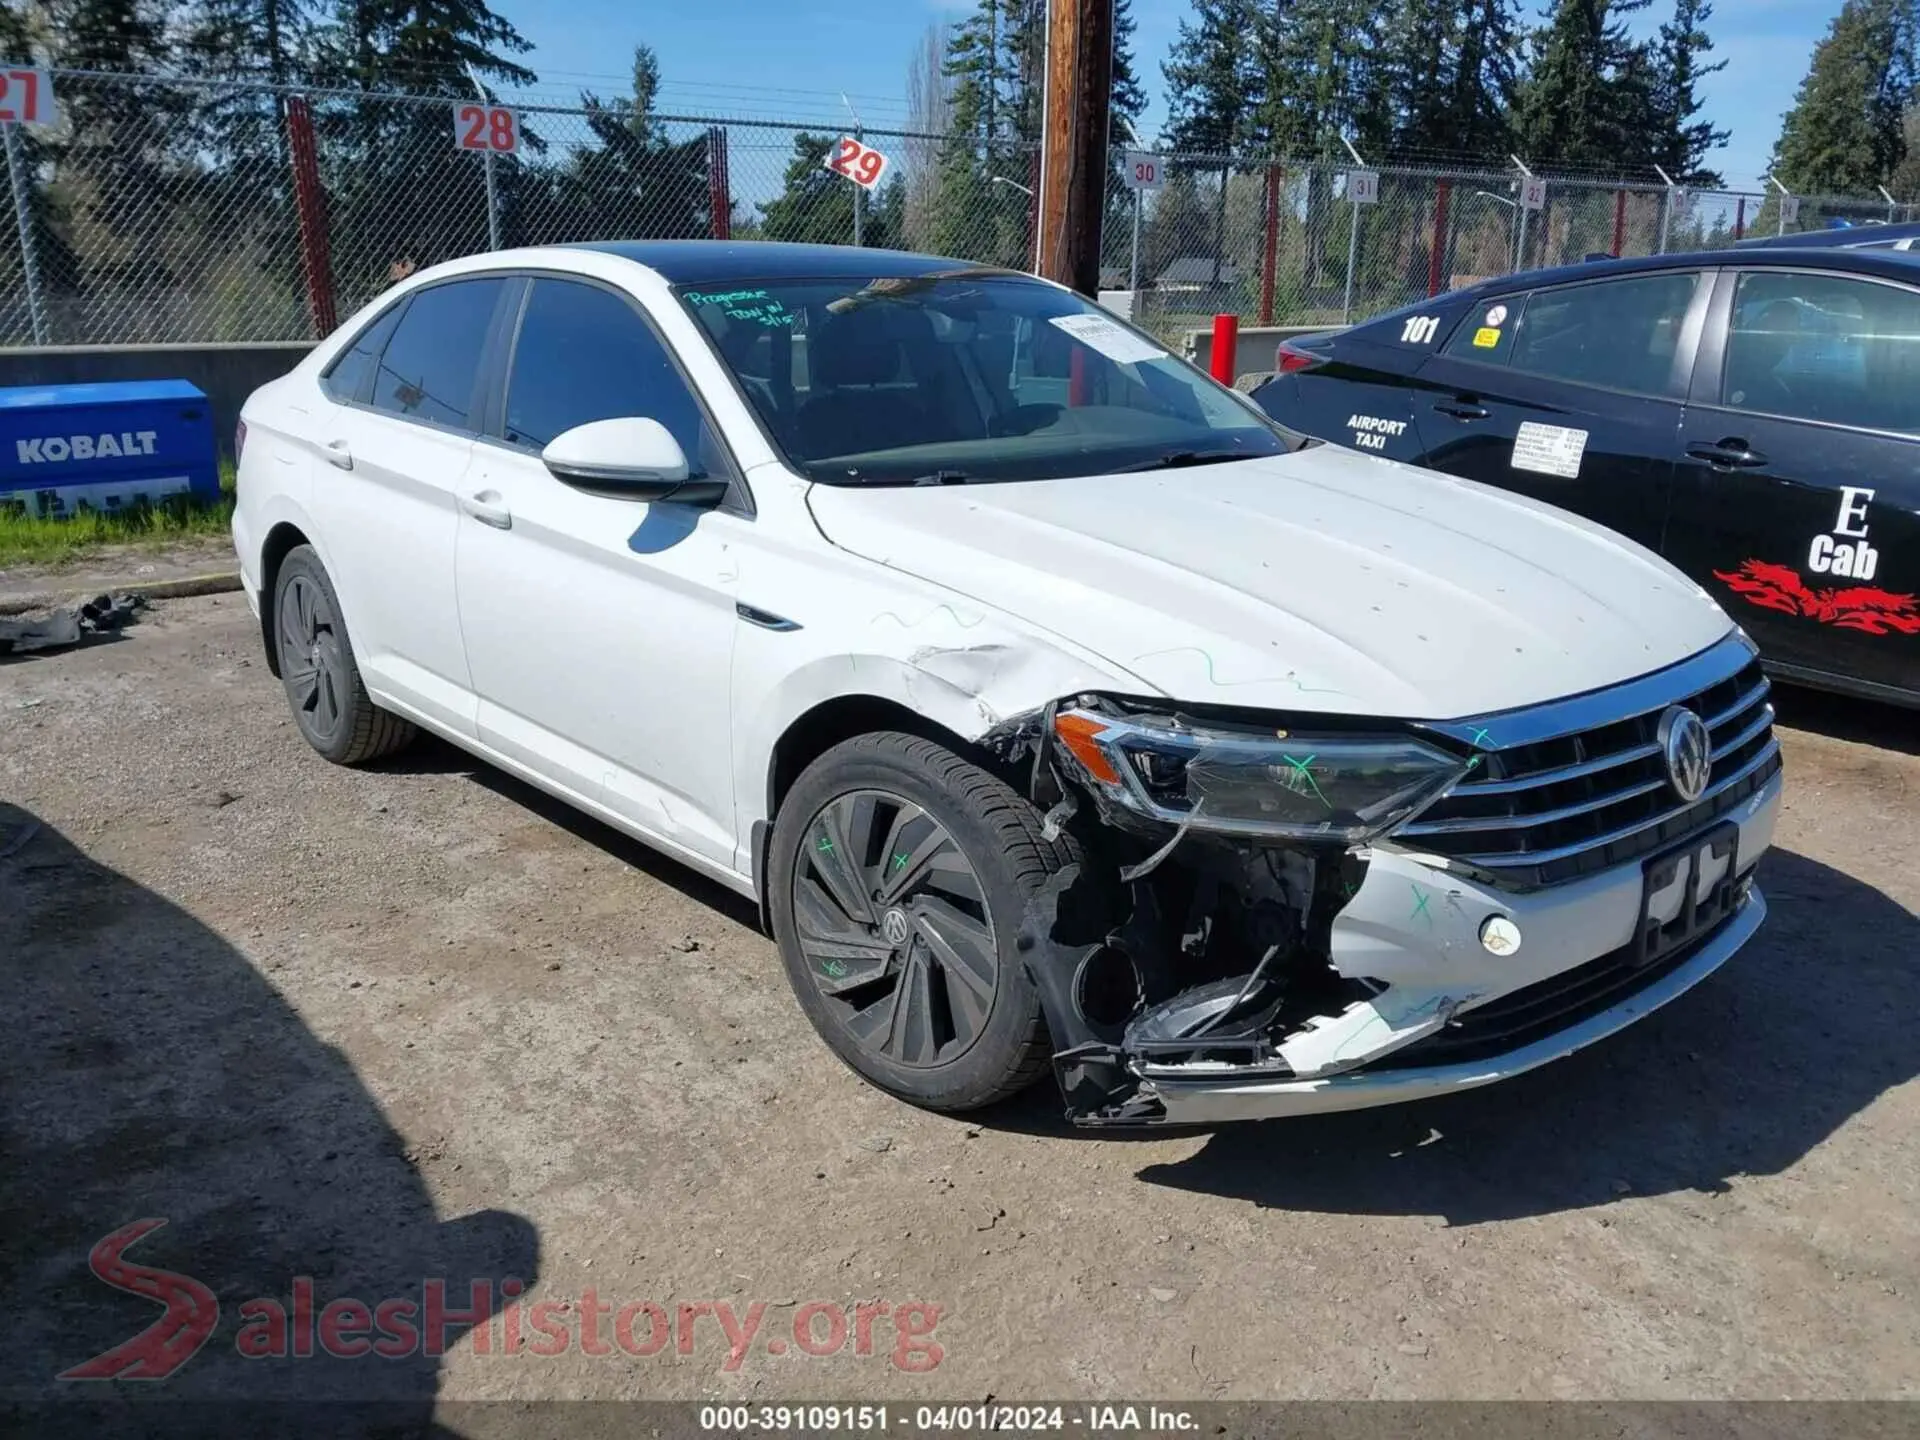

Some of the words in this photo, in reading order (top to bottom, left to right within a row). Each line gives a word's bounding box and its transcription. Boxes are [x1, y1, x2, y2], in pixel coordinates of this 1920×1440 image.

[461, 107, 514, 150] 28
[831, 140, 882, 184] 29
[1135, 163, 1154, 182] 30
[1356, 179, 1371, 196] 31
[1400, 315, 1440, 344] 101
[1347, 414, 1407, 436] AIRPORT
[1355, 431, 1386, 449] TAXI
[16, 431, 157, 464] KOBALT
[1832, 485, 1875, 538] E
[1808, 534, 1879, 580] Cab
